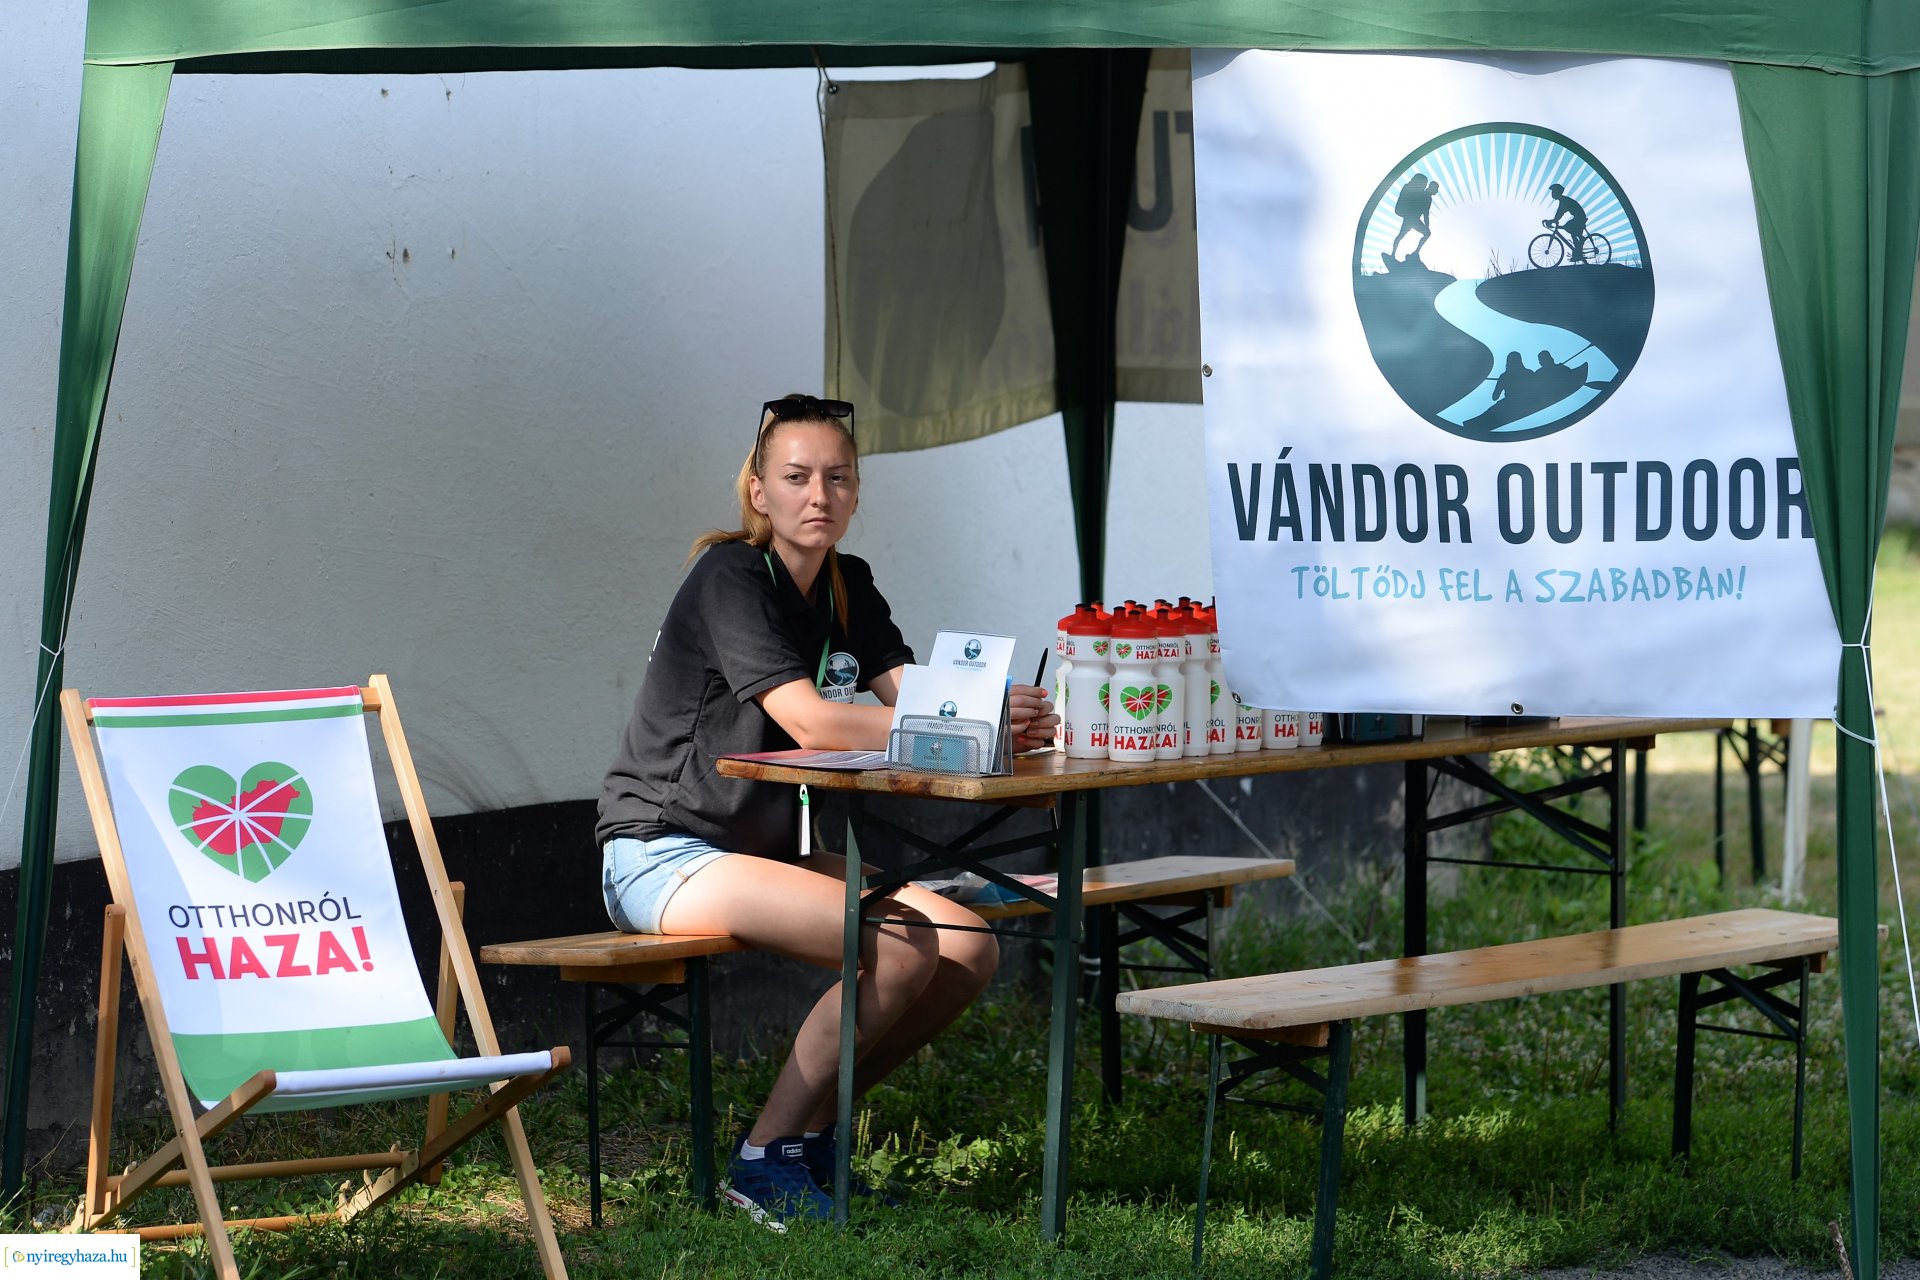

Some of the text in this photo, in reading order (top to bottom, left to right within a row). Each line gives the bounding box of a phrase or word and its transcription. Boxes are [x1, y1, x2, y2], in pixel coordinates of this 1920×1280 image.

[1227, 447, 1814, 544] VÁNDOR OUTDOOR
[1291, 564, 1746, 603] TÖLTŐDJ FEL A SZABADBAN!
[168, 891, 362, 929] OTTHONRÓL
[176, 926, 374, 980] HAZA!
